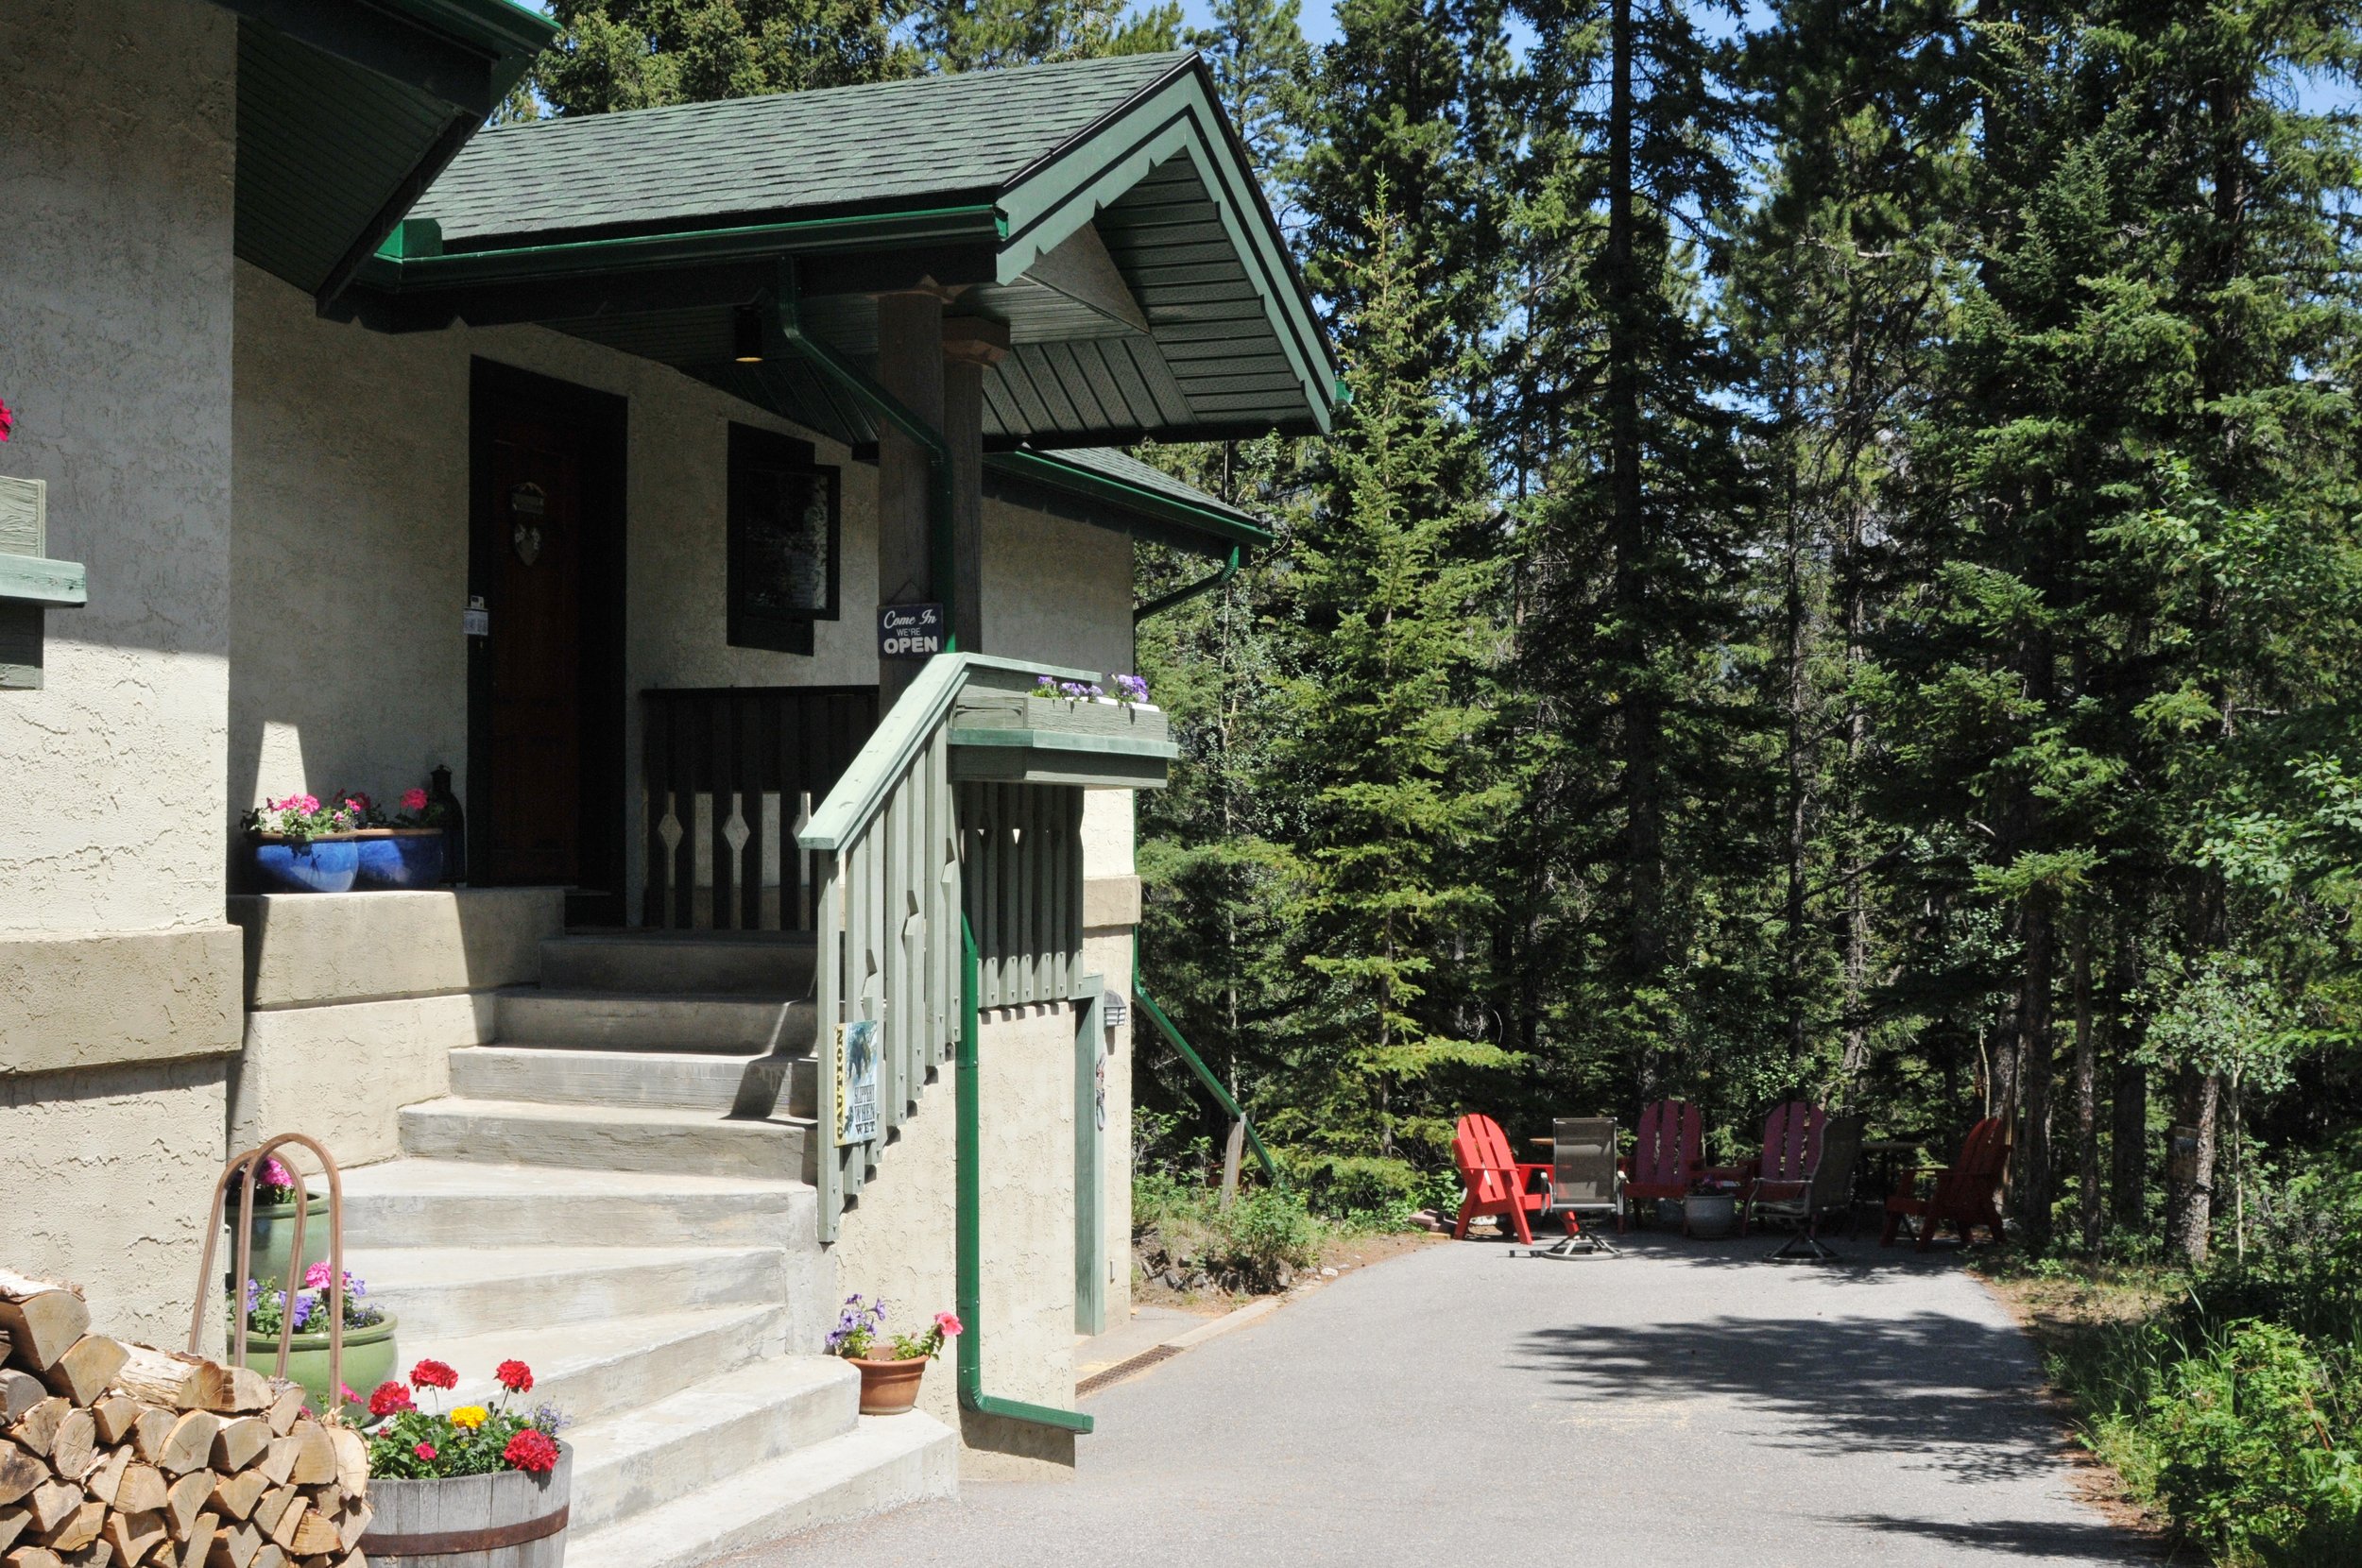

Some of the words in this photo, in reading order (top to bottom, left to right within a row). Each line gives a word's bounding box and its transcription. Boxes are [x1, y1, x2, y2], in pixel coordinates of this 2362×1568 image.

[883, 610, 916, 629] Come
[919, 609, 936, 624] In
[897, 627, 921, 637] WE'RE
[883, 636, 938, 655] OPEN
[854, 1084, 875, 1104] SLIPPERY
[854, 1102, 875, 1123] WHEN
[855, 1120, 876, 1134] WET
